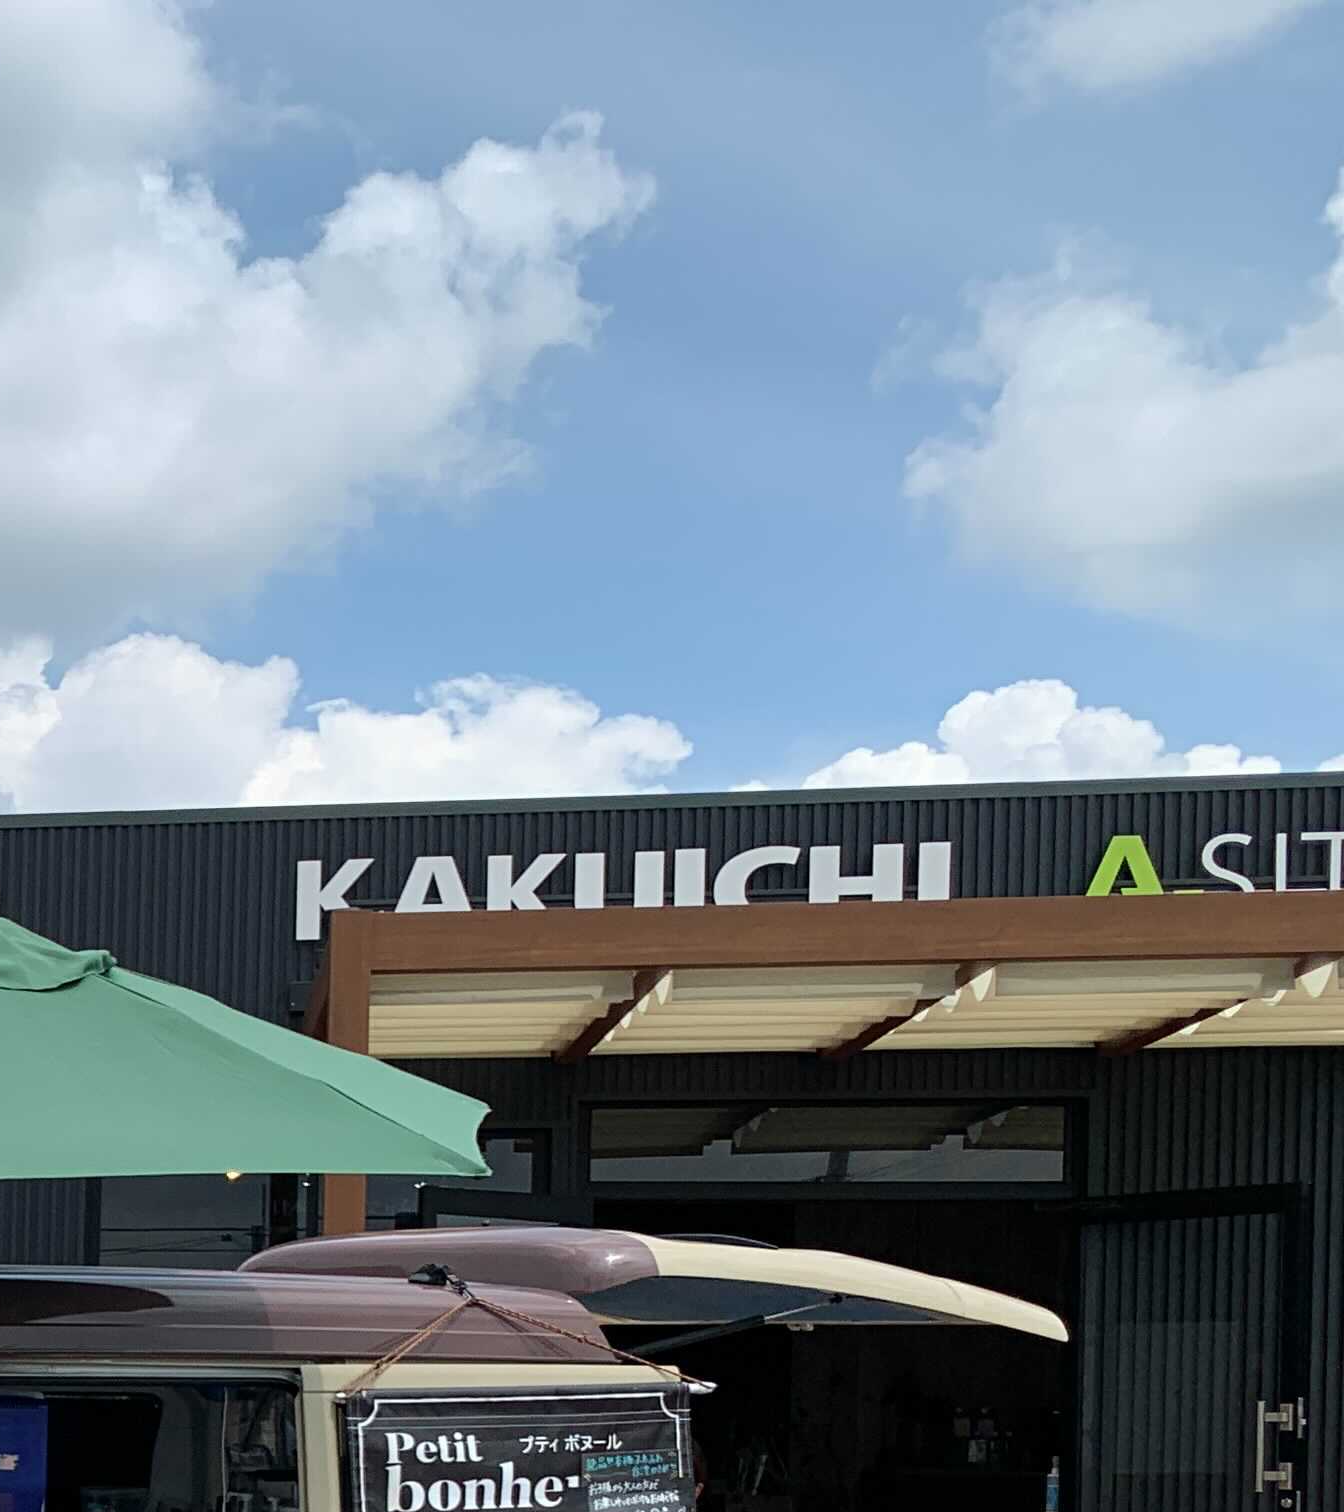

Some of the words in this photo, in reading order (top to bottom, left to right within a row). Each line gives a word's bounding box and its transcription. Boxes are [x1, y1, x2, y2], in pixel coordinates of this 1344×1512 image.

[384, 1431, 484, 1464] Petit
[519, 1436, 559, 1454] プティ
[563, 1433, 623, 1452] ボヌール
